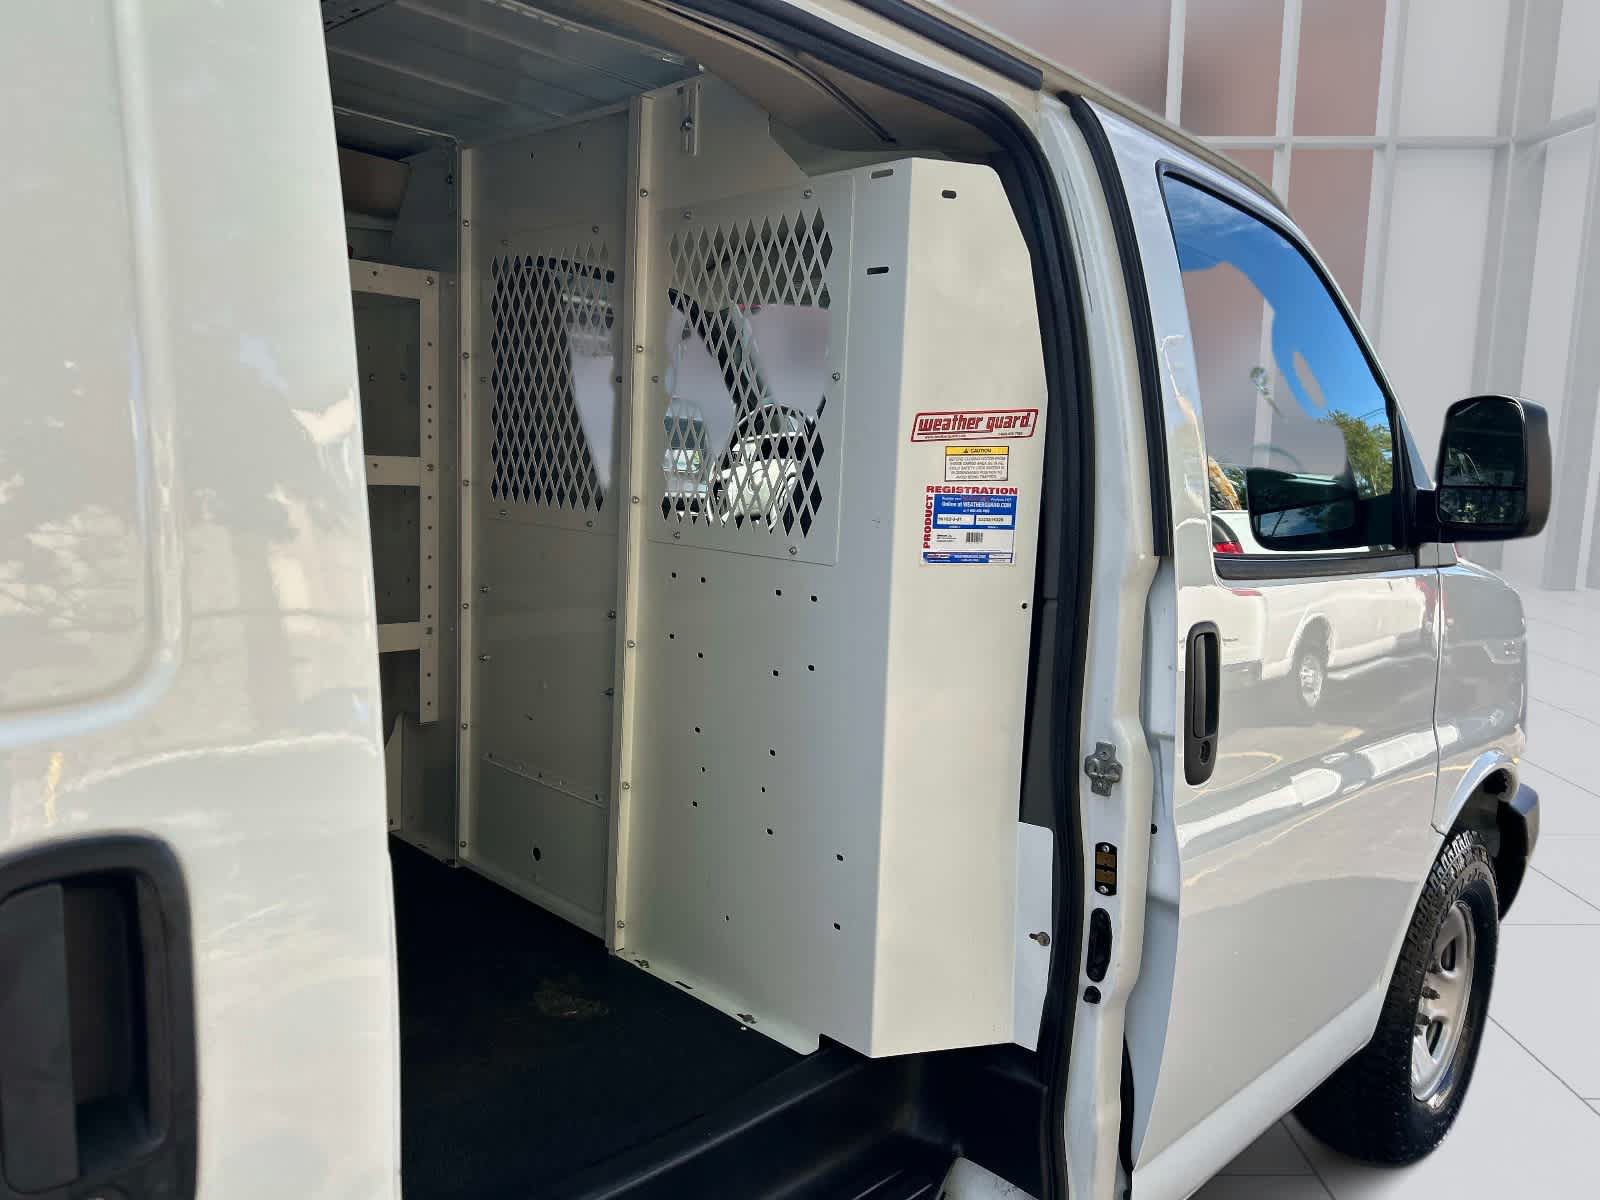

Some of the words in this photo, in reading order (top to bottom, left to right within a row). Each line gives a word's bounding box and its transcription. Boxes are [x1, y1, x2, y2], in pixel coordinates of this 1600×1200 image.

[918, 414, 983, 432] weather
[985, 412, 1031, 433] guard
[926, 485, 1018, 494] REGISTRATION
[923, 494, 933, 549] PRODUCT
